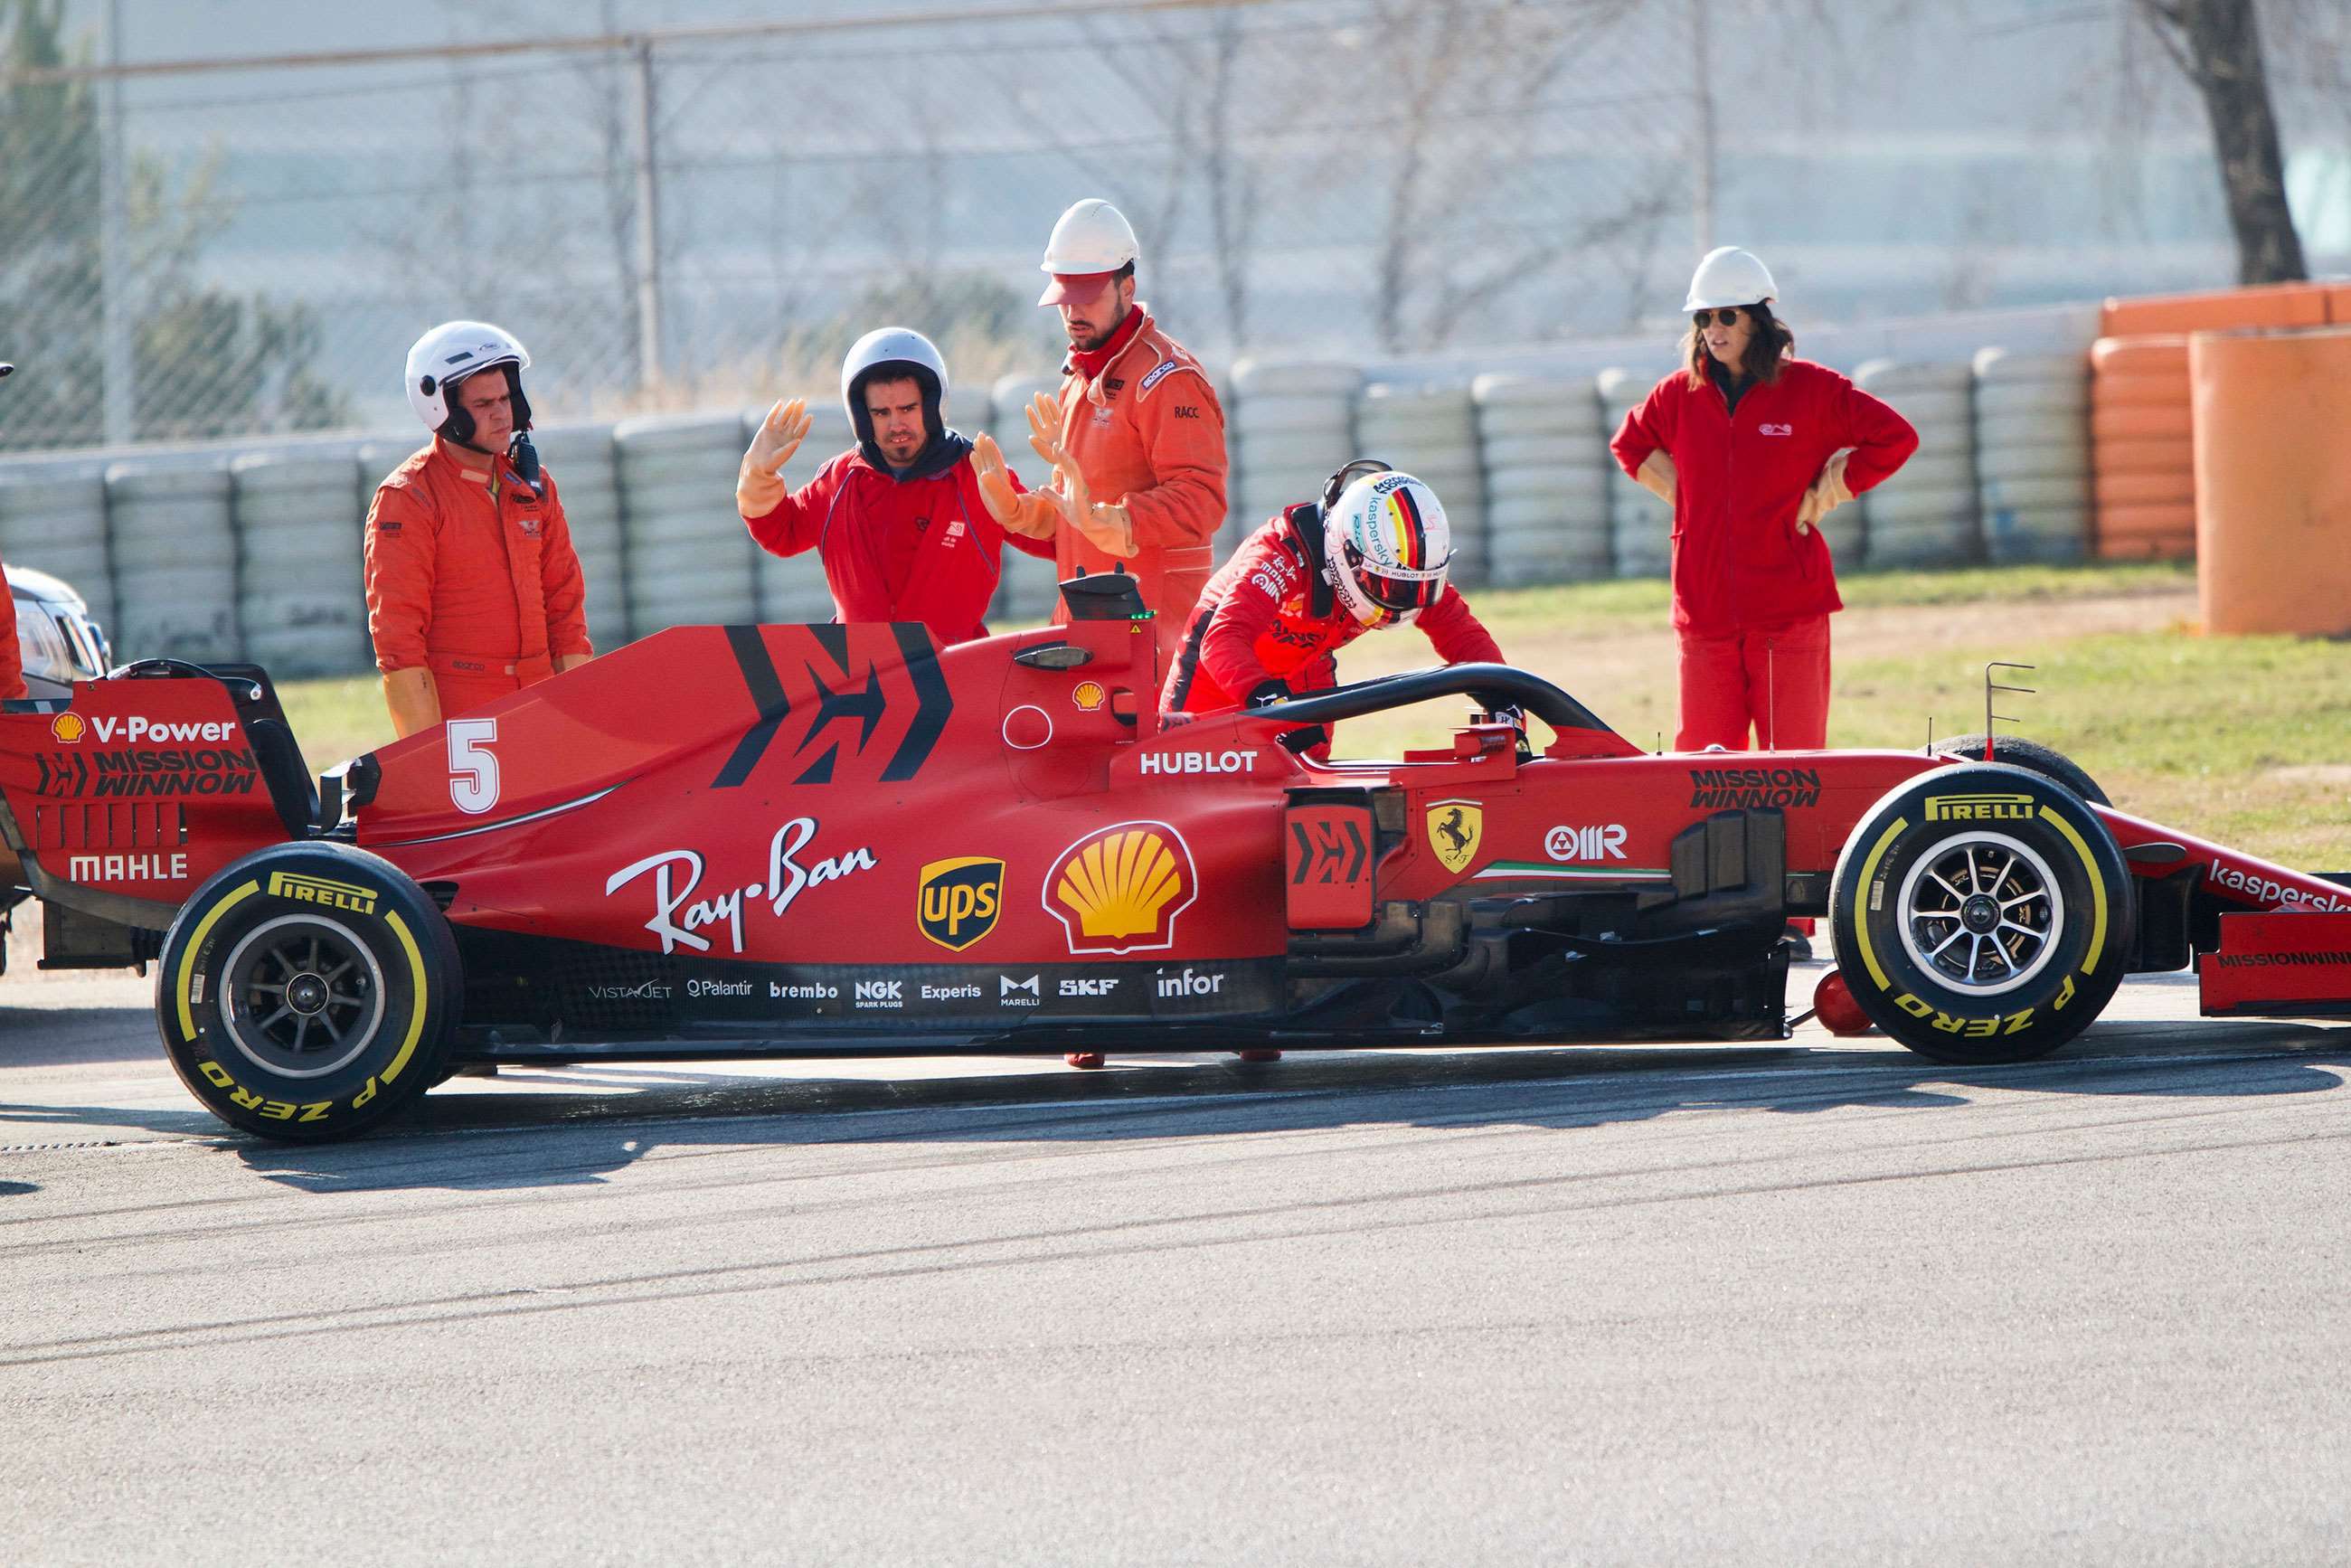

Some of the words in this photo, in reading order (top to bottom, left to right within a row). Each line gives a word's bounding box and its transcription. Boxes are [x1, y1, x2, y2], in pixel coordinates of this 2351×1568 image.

[1175, 406, 1200, 419] RACC
[1365, 496, 1393, 568] kaspersky
[1392, 571, 1419, 579] HUBLOT
[91, 716, 236, 742] V-Power
[92, 749, 256, 772] MISSION
[447, 718, 500, 815] 5
[1140, 751, 1258, 775] HUBLOT
[94, 771, 257, 797] WINNOW
[1689, 769, 1821, 789] MISSION
[1689, 788, 1820, 808] WINNOW
[1924, 793, 2035, 821] PIRELLI
[70, 854, 188, 882] MAHLE
[268, 871, 378, 915] PIRELLI
[2209, 859, 2351, 912] kaspersk
[924, 883, 996, 935] ups
[702, 979, 753, 997] Palantir
[770, 981, 839, 998] brembo
[854, 980, 903, 1000] NGK
[921, 984, 982, 1001] Experis
[1059, 979, 1119, 996] SKF
[1157, 968, 1223, 997] infor
[2054, 975, 2075, 1011] P
[880, 1000, 902, 1008] PLUGS
[1000, 998, 1040, 1006] MARELLI
[1893, 993, 2035, 1037] ZERO
[197, 1061, 333, 1122] ZERO
[352, 1076, 377, 1110] P
